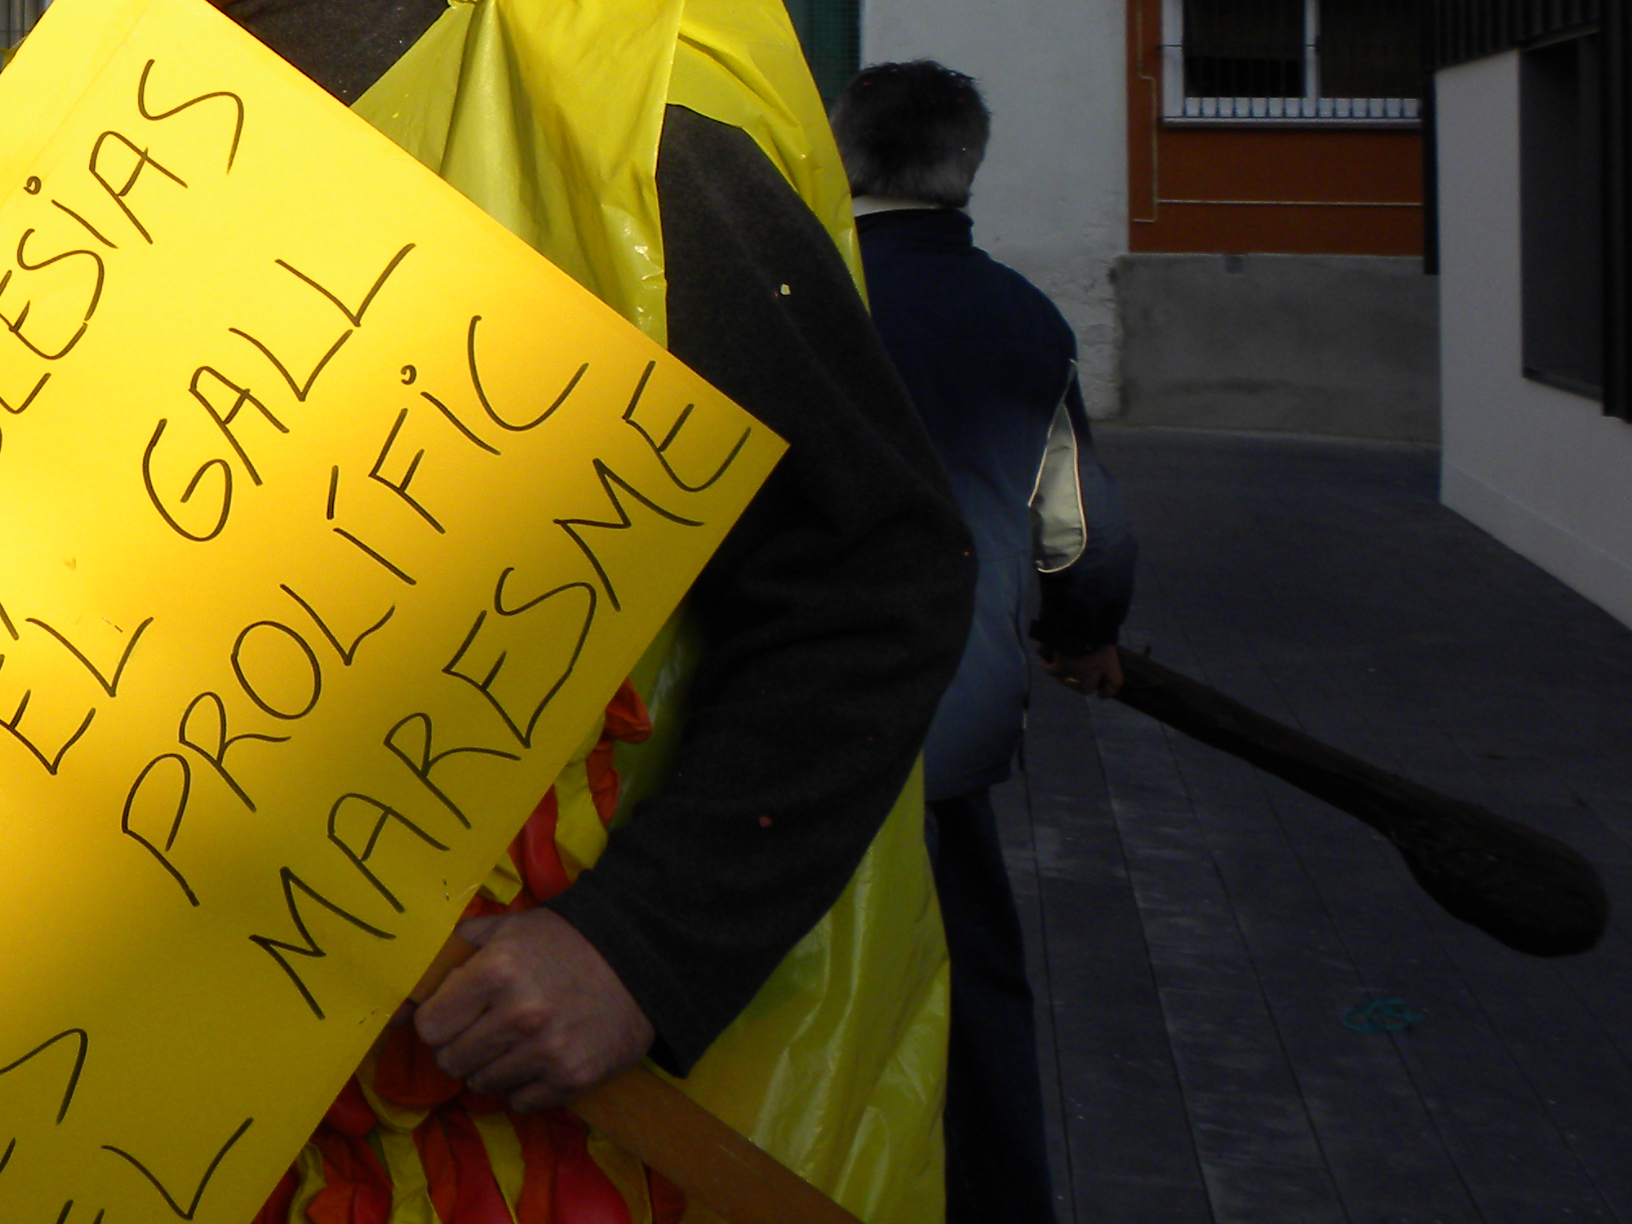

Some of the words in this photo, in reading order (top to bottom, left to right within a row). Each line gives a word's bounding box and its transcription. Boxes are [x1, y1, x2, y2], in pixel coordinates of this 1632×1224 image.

[121, 314, 589, 908] PROLÍFIC
[142, 242, 416, 542] GALL
[248, 360, 752, 1020] MARESME
